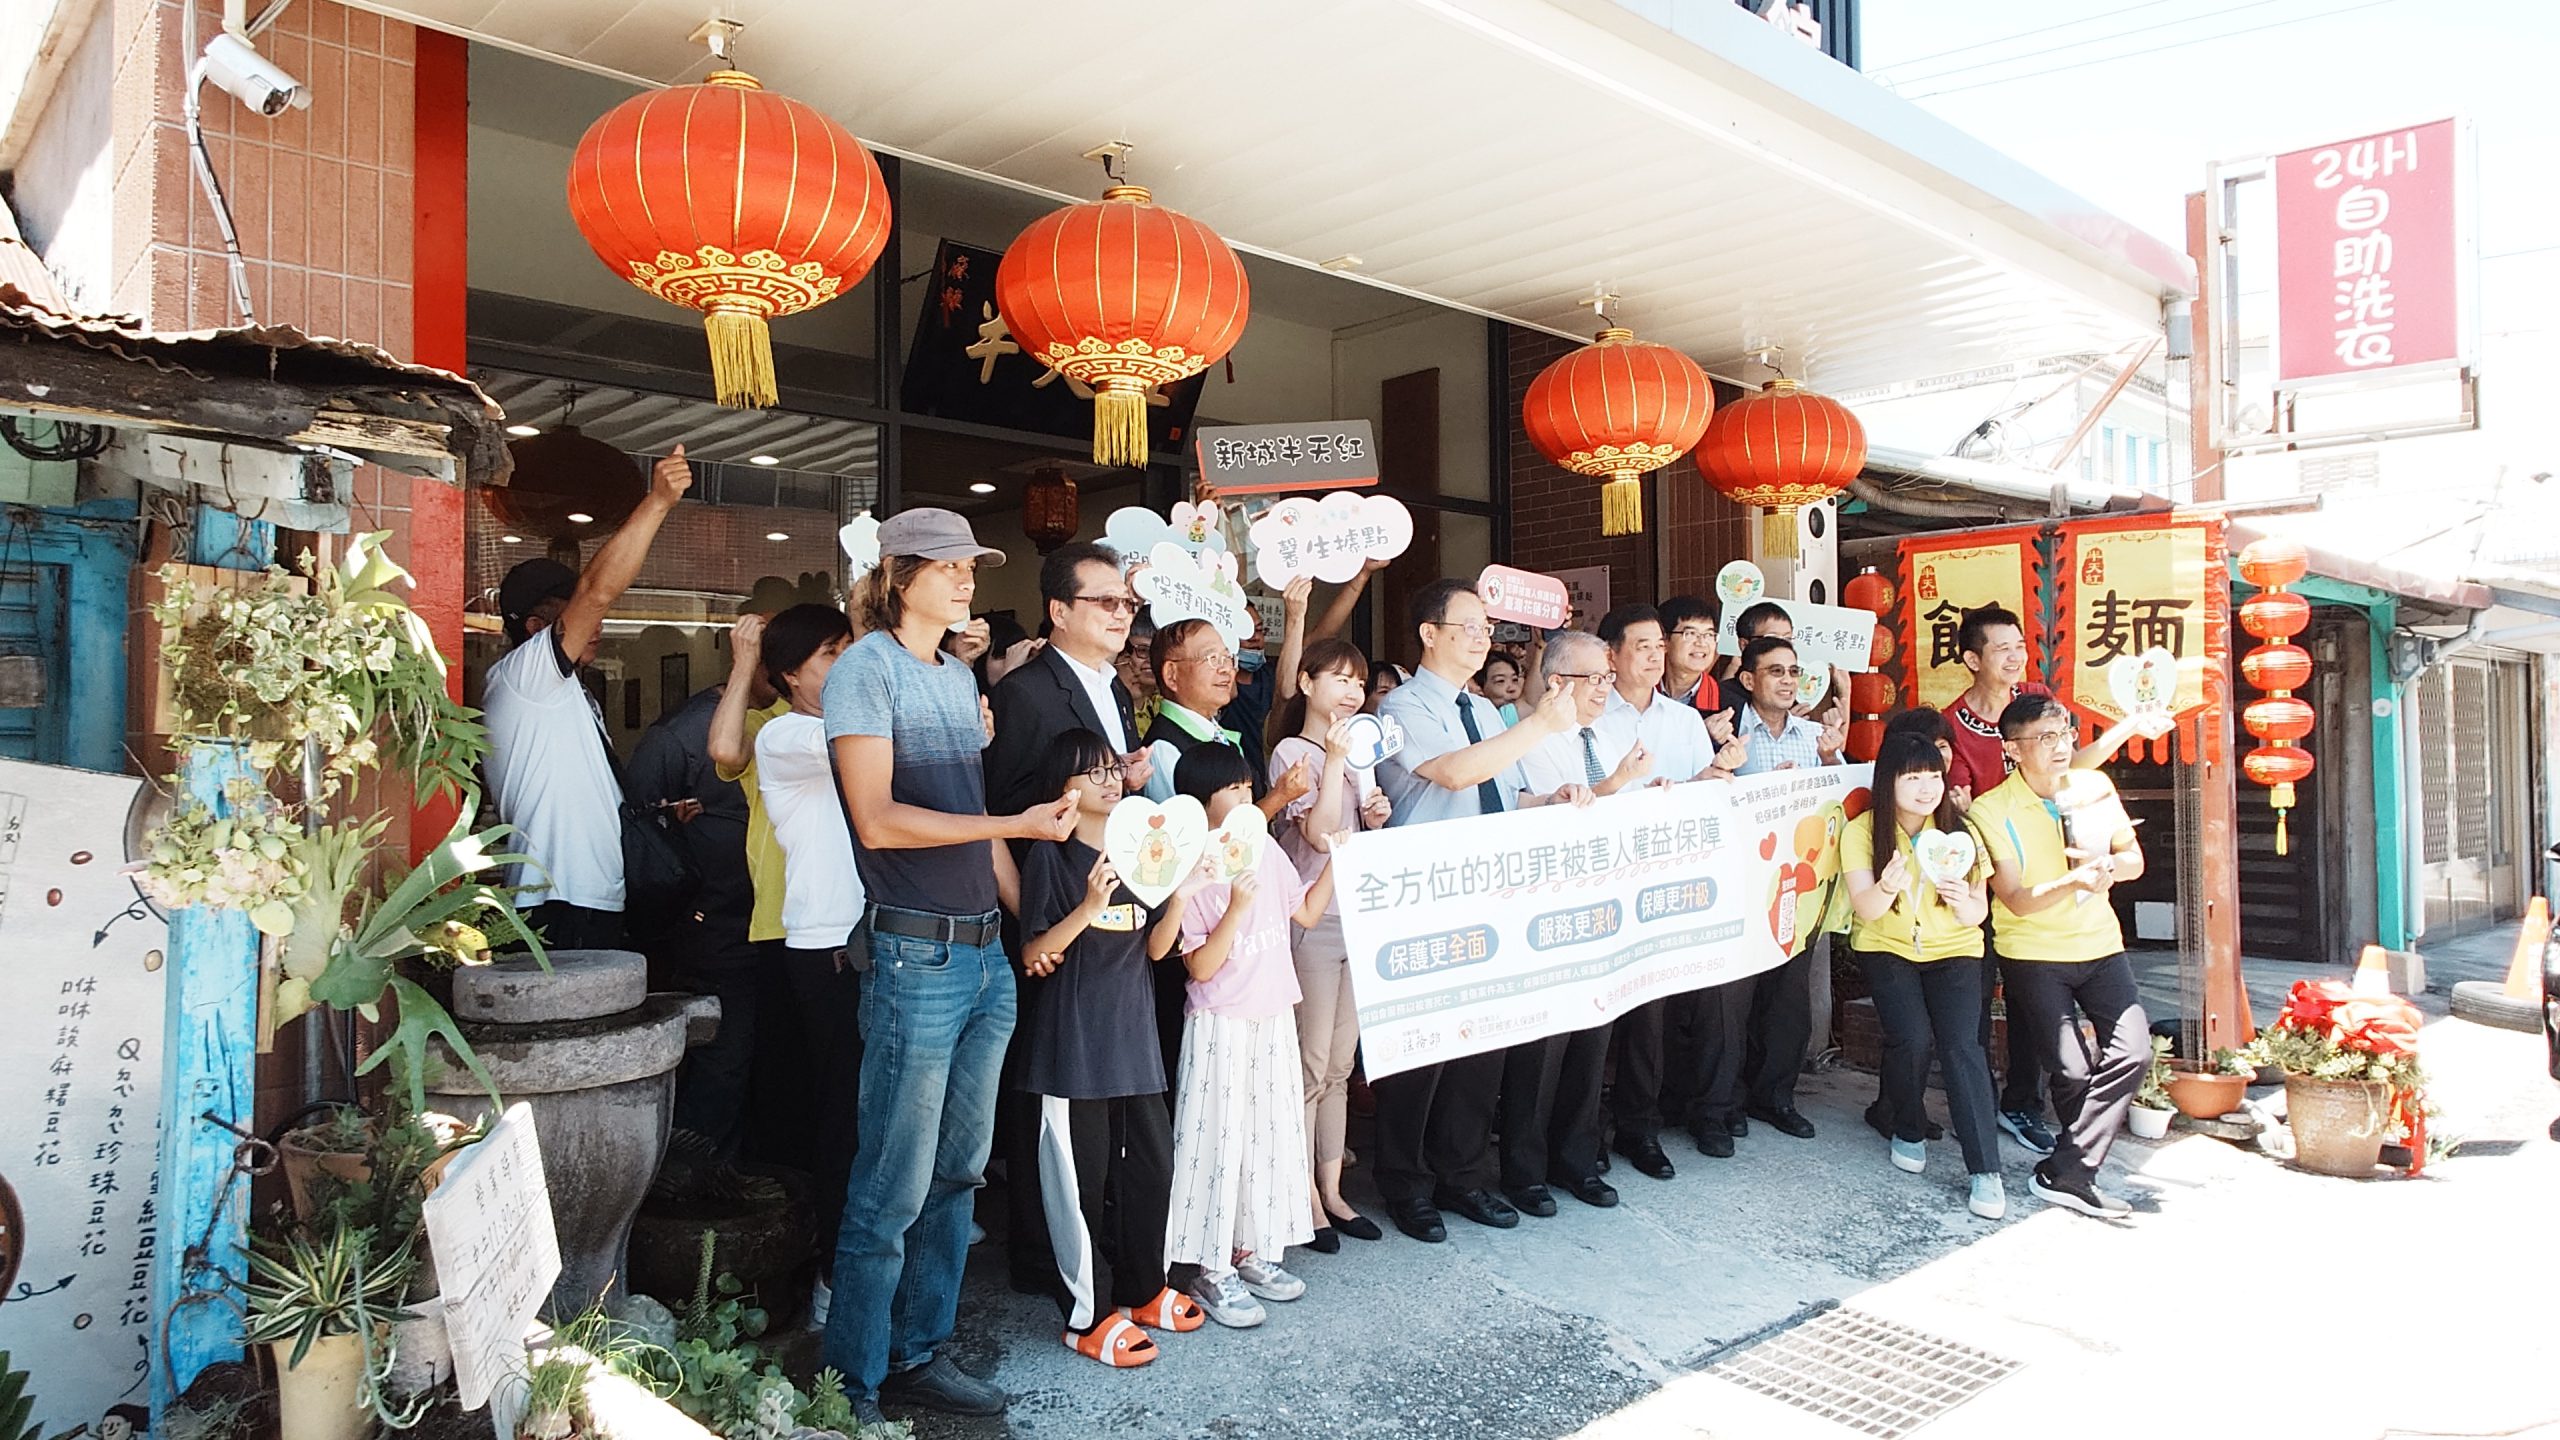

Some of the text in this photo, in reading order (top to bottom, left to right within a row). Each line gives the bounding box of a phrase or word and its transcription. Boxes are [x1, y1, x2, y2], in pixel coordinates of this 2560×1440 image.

[2313, 131, 2418, 189] 24H
[2333, 184, 2396, 367] 自助洗衣
[1214, 434, 1364, 471] 新城半天紅
[1921, 566, 1937, 599] 半天紅
[2086, 549, 2104, 584] 半天紅
[1152, 575, 1234, 629] 保護服務
[1355, 815, 1723, 913] 全方位的犯罪被害人權益保障
[1640, 881, 1710, 919] 保障更升級
[1537, 903, 1618, 947] 服務更深化
[1387, 928, 1488, 977] 保護更全面
